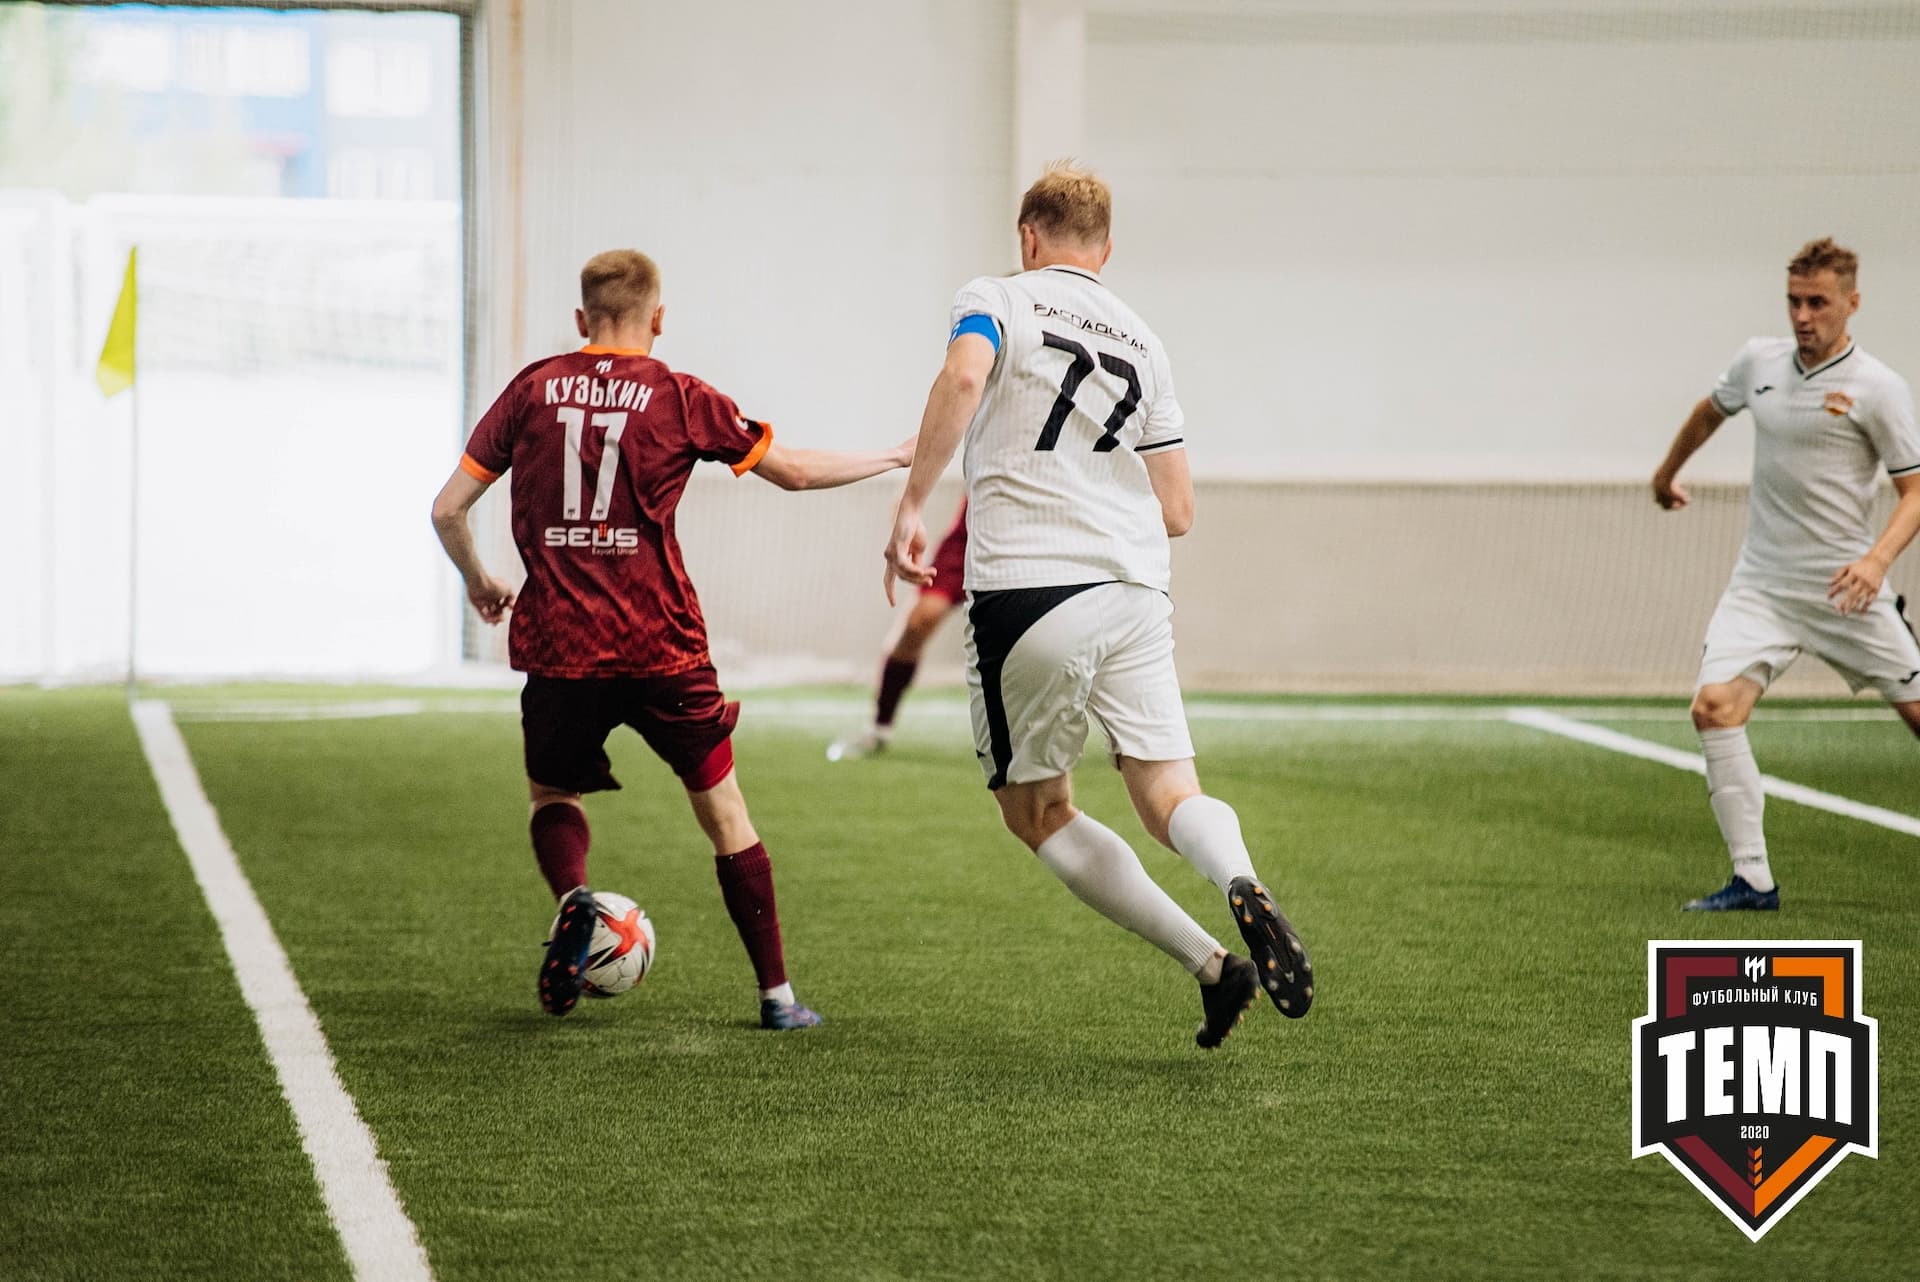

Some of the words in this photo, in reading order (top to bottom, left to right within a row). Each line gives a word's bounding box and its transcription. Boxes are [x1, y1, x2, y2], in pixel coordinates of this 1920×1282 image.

[544, 375, 654, 413] КУЗЬКИН
[1033, 330, 1143, 452] 77
[555, 406, 629, 522] 17
